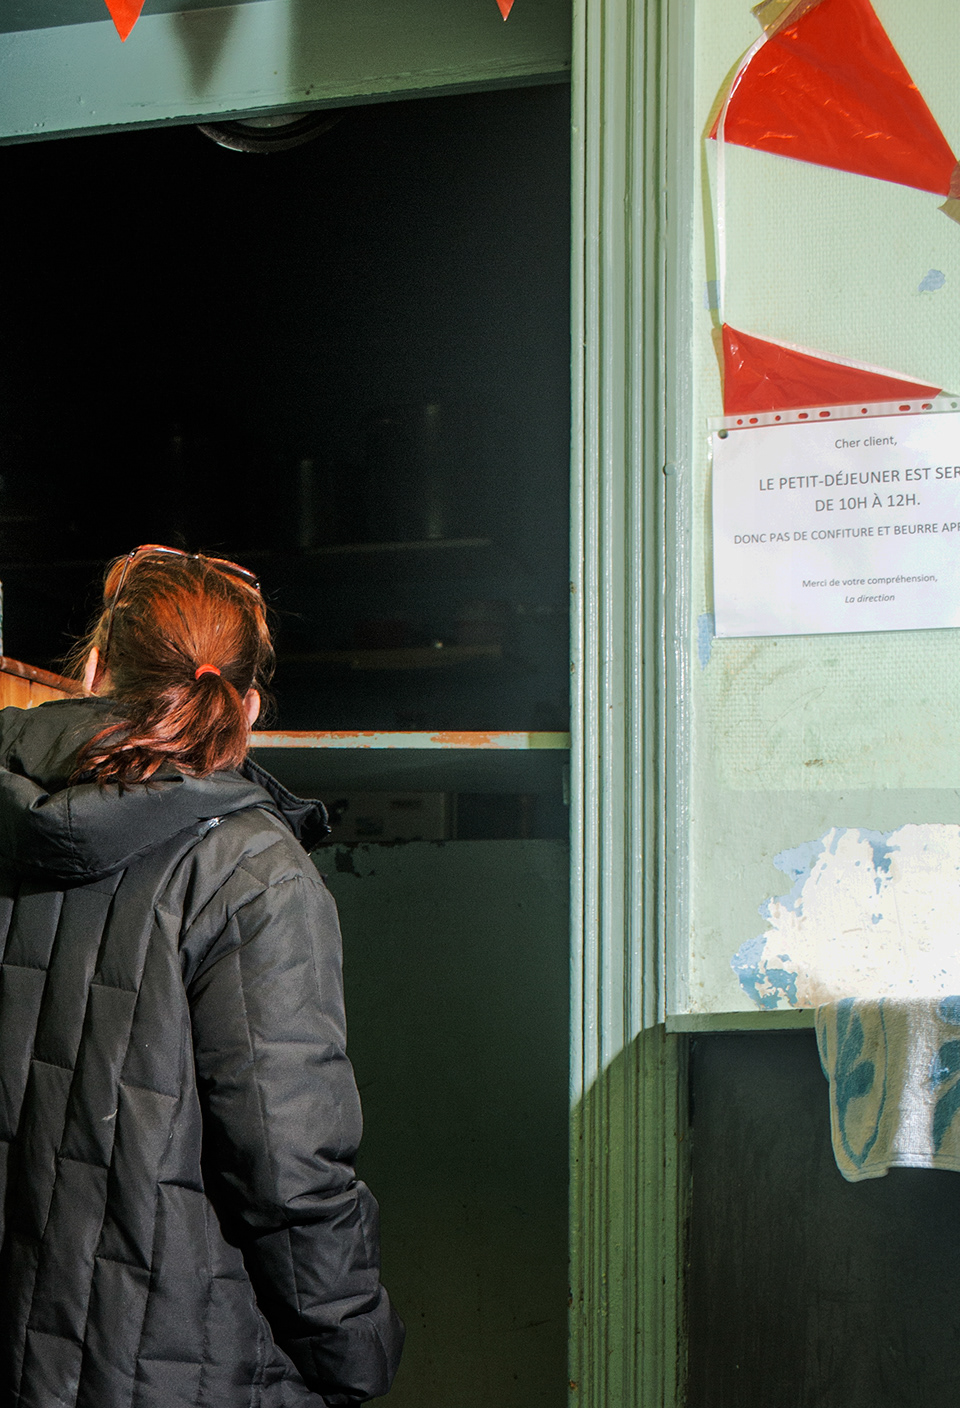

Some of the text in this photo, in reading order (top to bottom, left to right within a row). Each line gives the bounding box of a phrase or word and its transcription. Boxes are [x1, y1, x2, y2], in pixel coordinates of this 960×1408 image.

[835, 436, 897, 449] Cher client,
[760, 478, 774, 491] LE
[779, 470, 900, 489] PETIT-DÉJEUNER
[905, 468, 931, 481] EST
[815, 493, 920, 512] DE 10H À 12H.
[734, 533, 767, 544] DONC
[770, 532, 790, 542] PAS
[793, 531, 807, 541] DE
[811, 527, 874, 540] CONFITURE
[878, 526, 891, 536] ET
[894, 523, 938, 535] BEURRE
[802, 579, 827, 587] Merci
[867, 574, 938, 585] compréhension,
[857, 594, 895, 602] direction
